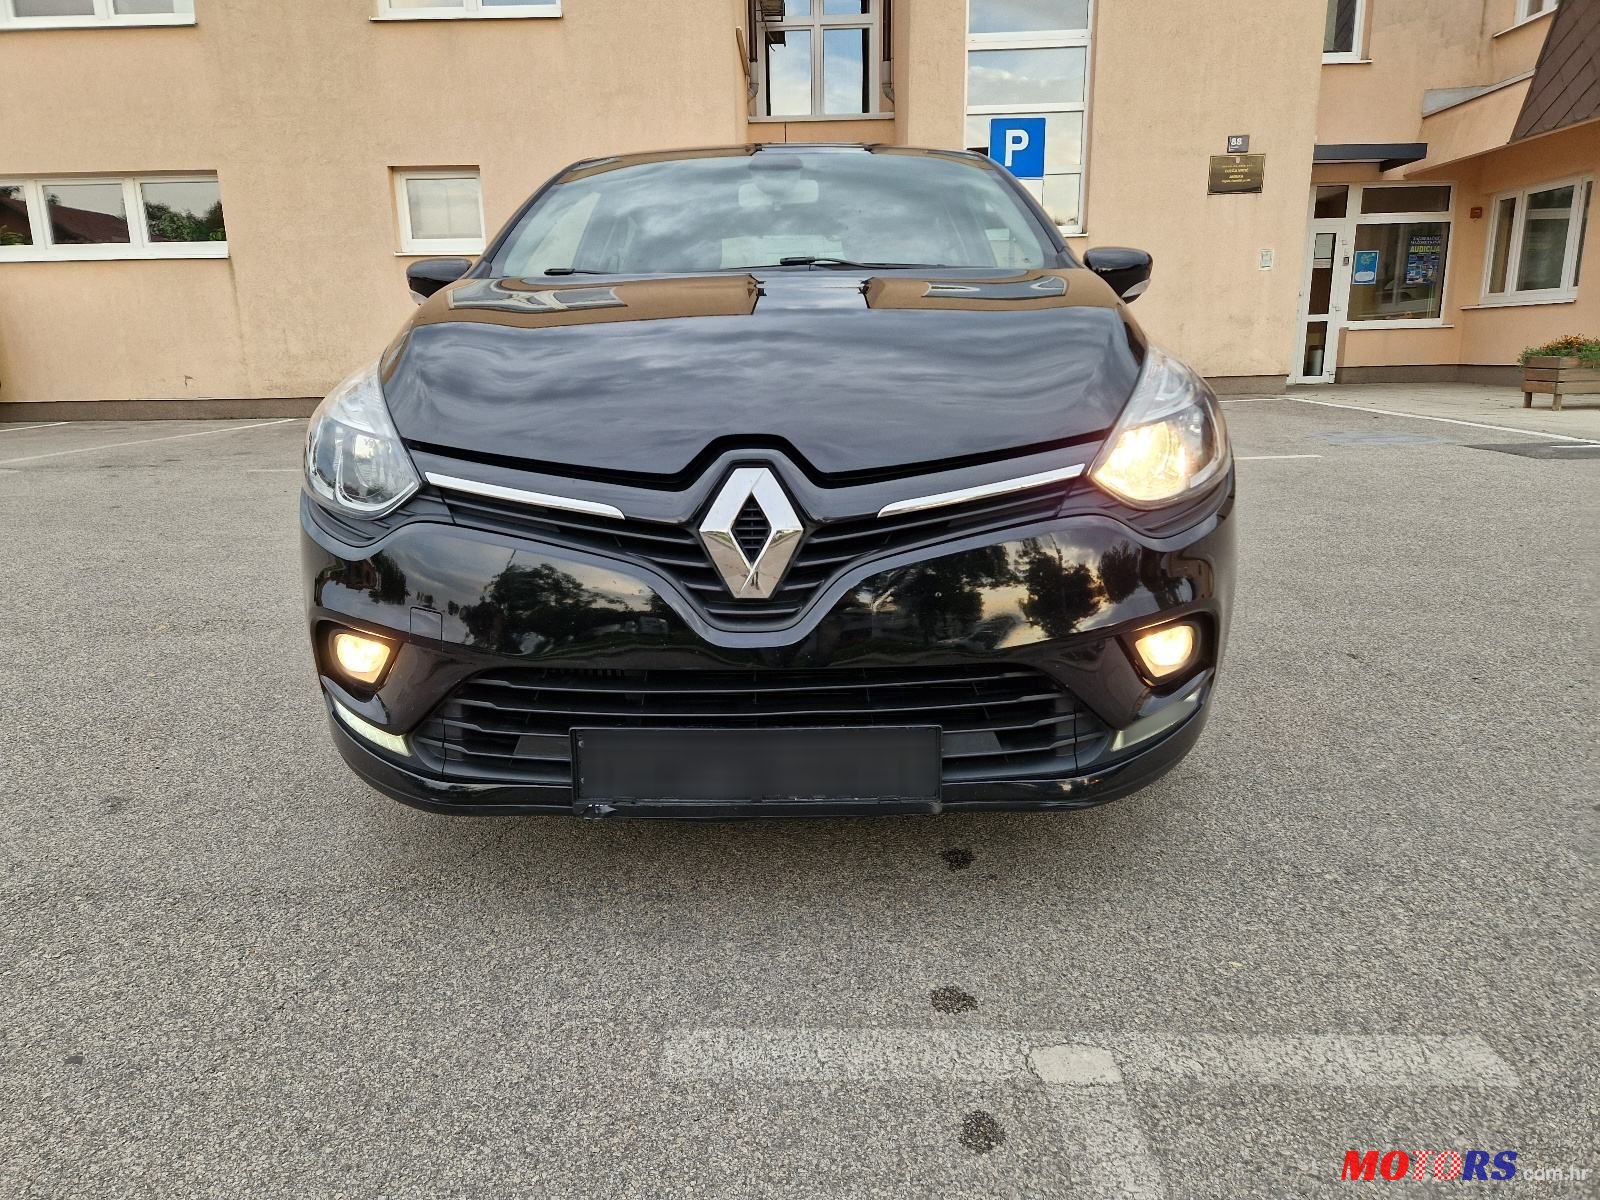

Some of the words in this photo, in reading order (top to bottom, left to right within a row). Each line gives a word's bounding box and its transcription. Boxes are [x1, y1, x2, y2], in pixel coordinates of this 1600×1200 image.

[1230, 137, 1242, 146] 88
[1004, 129, 1030, 167] P
[1409, 245, 1441, 253] AUDICIJA
